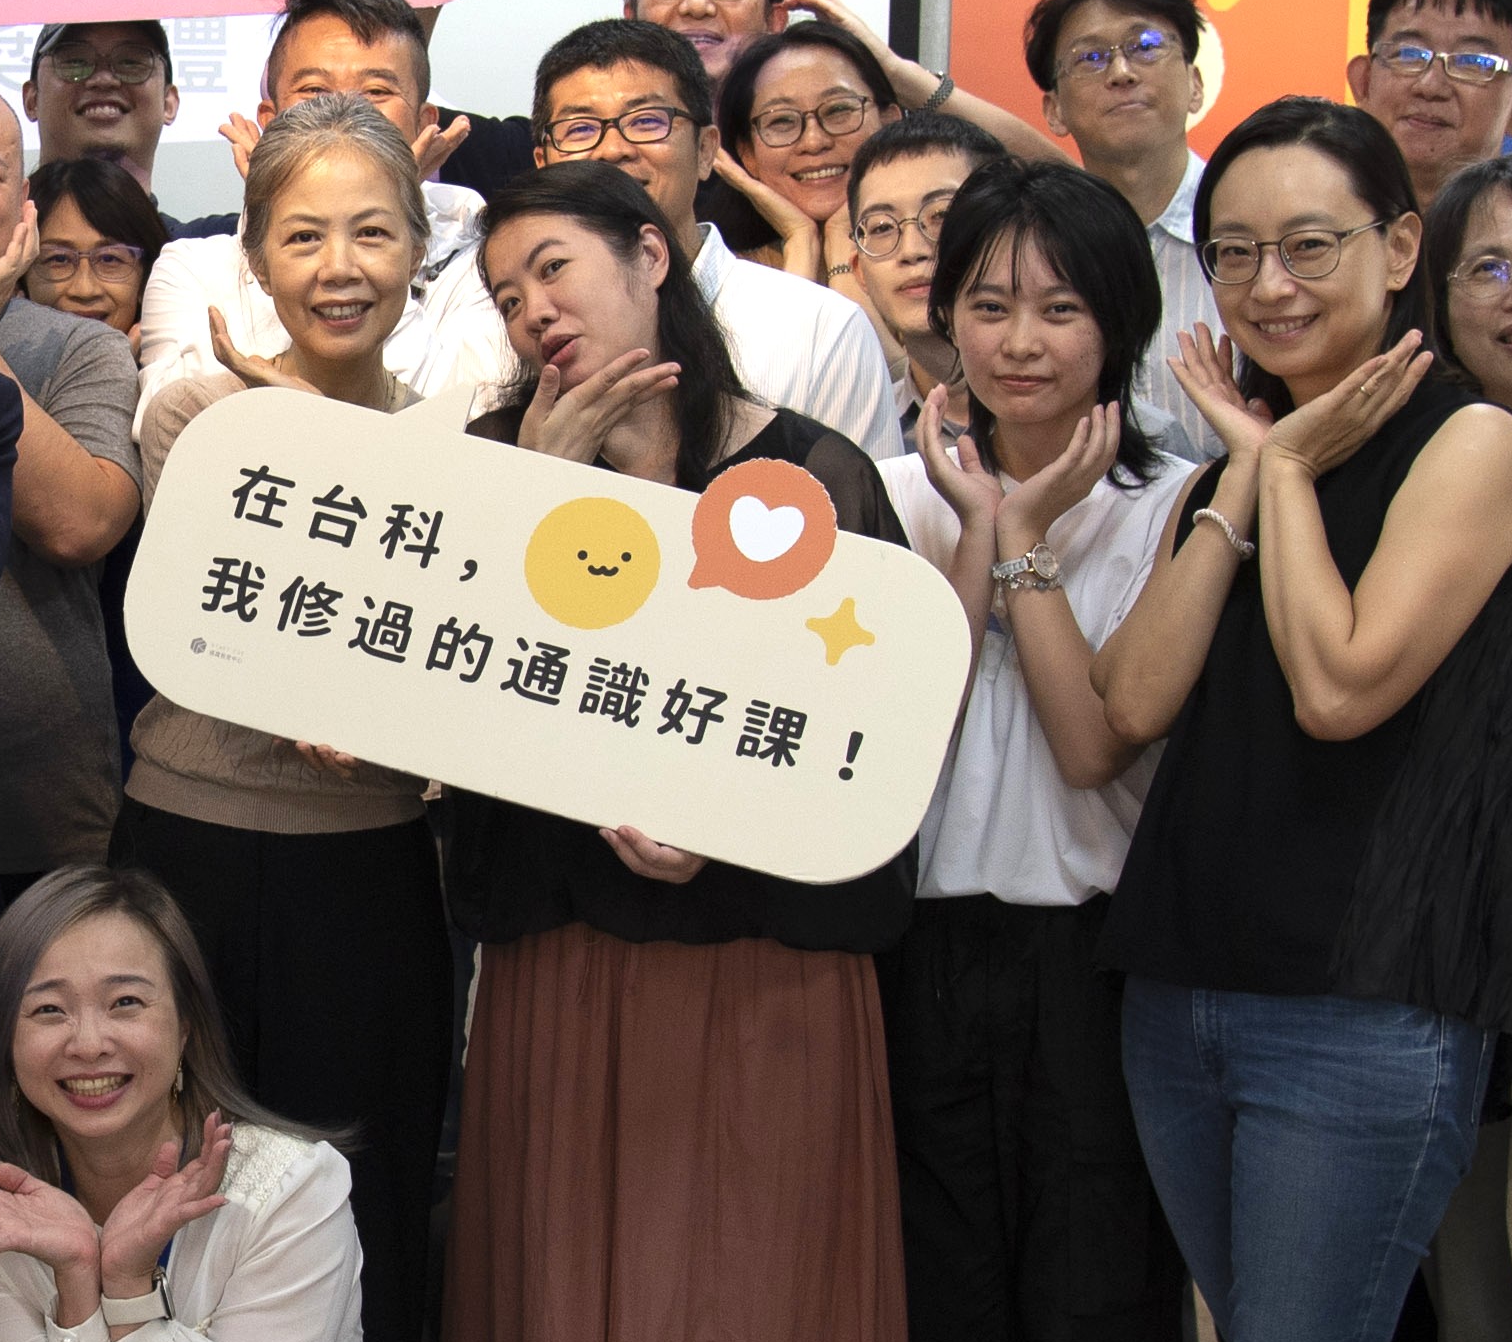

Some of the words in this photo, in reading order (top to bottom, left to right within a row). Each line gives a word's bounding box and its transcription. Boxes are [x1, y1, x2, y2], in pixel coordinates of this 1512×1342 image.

[232, 464, 479, 582] 在台科，
[200, 556, 865, 781] 我修過的通識好課！
